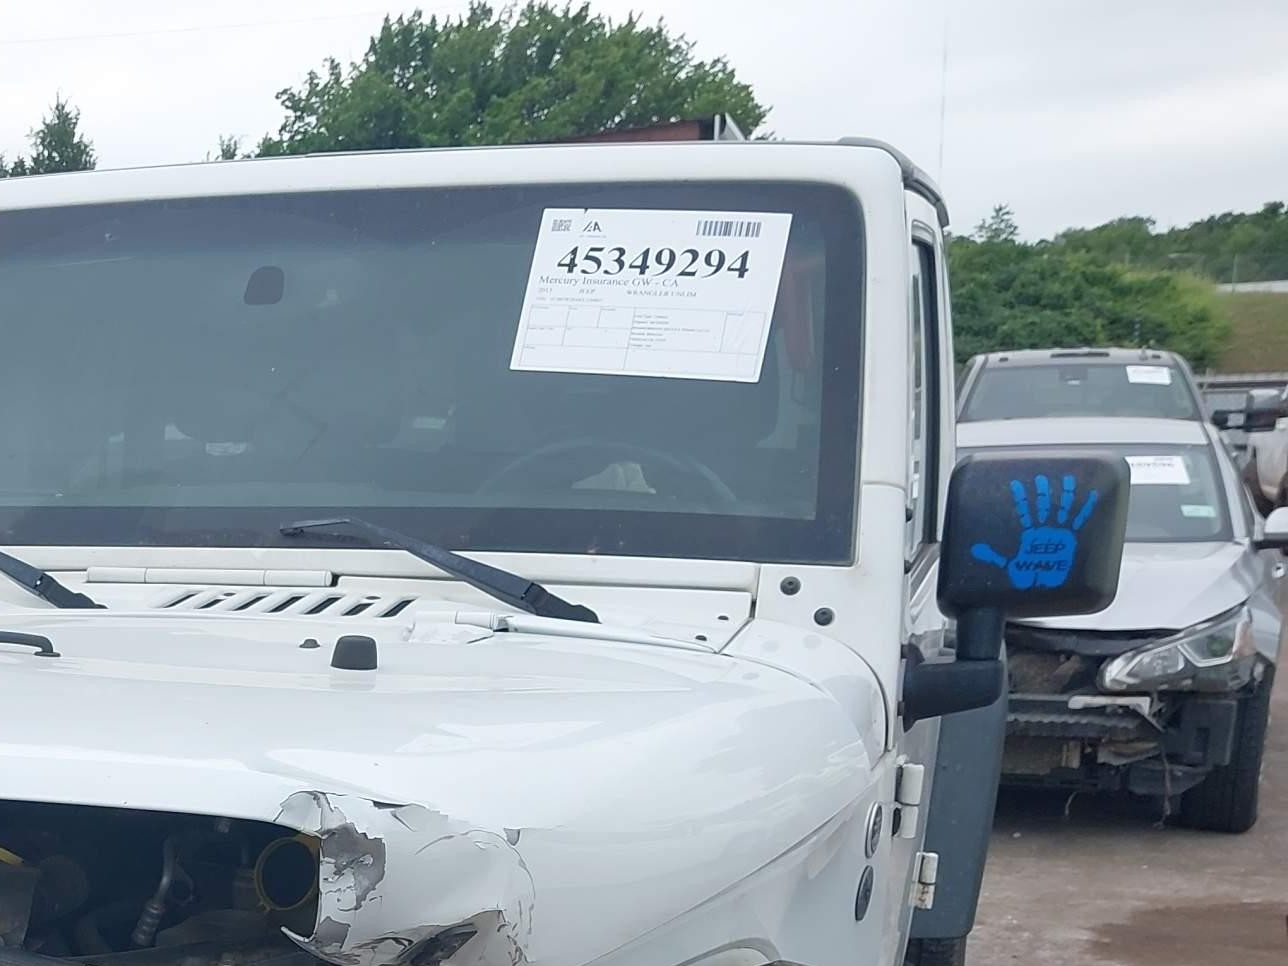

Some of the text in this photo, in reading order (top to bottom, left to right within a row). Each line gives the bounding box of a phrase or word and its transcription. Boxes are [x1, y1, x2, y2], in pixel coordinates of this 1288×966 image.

[557, 245, 751, 279] 45349294
[539, 275, 579, 287] Mercury
[582, 276, 629, 287] Insurance
[632, 278, 652, 287] GW
[662, 278, 679, 288] CA
[1025, 541, 1066, 554] JEEP
[1015, 560, 1067, 572] WAVE
